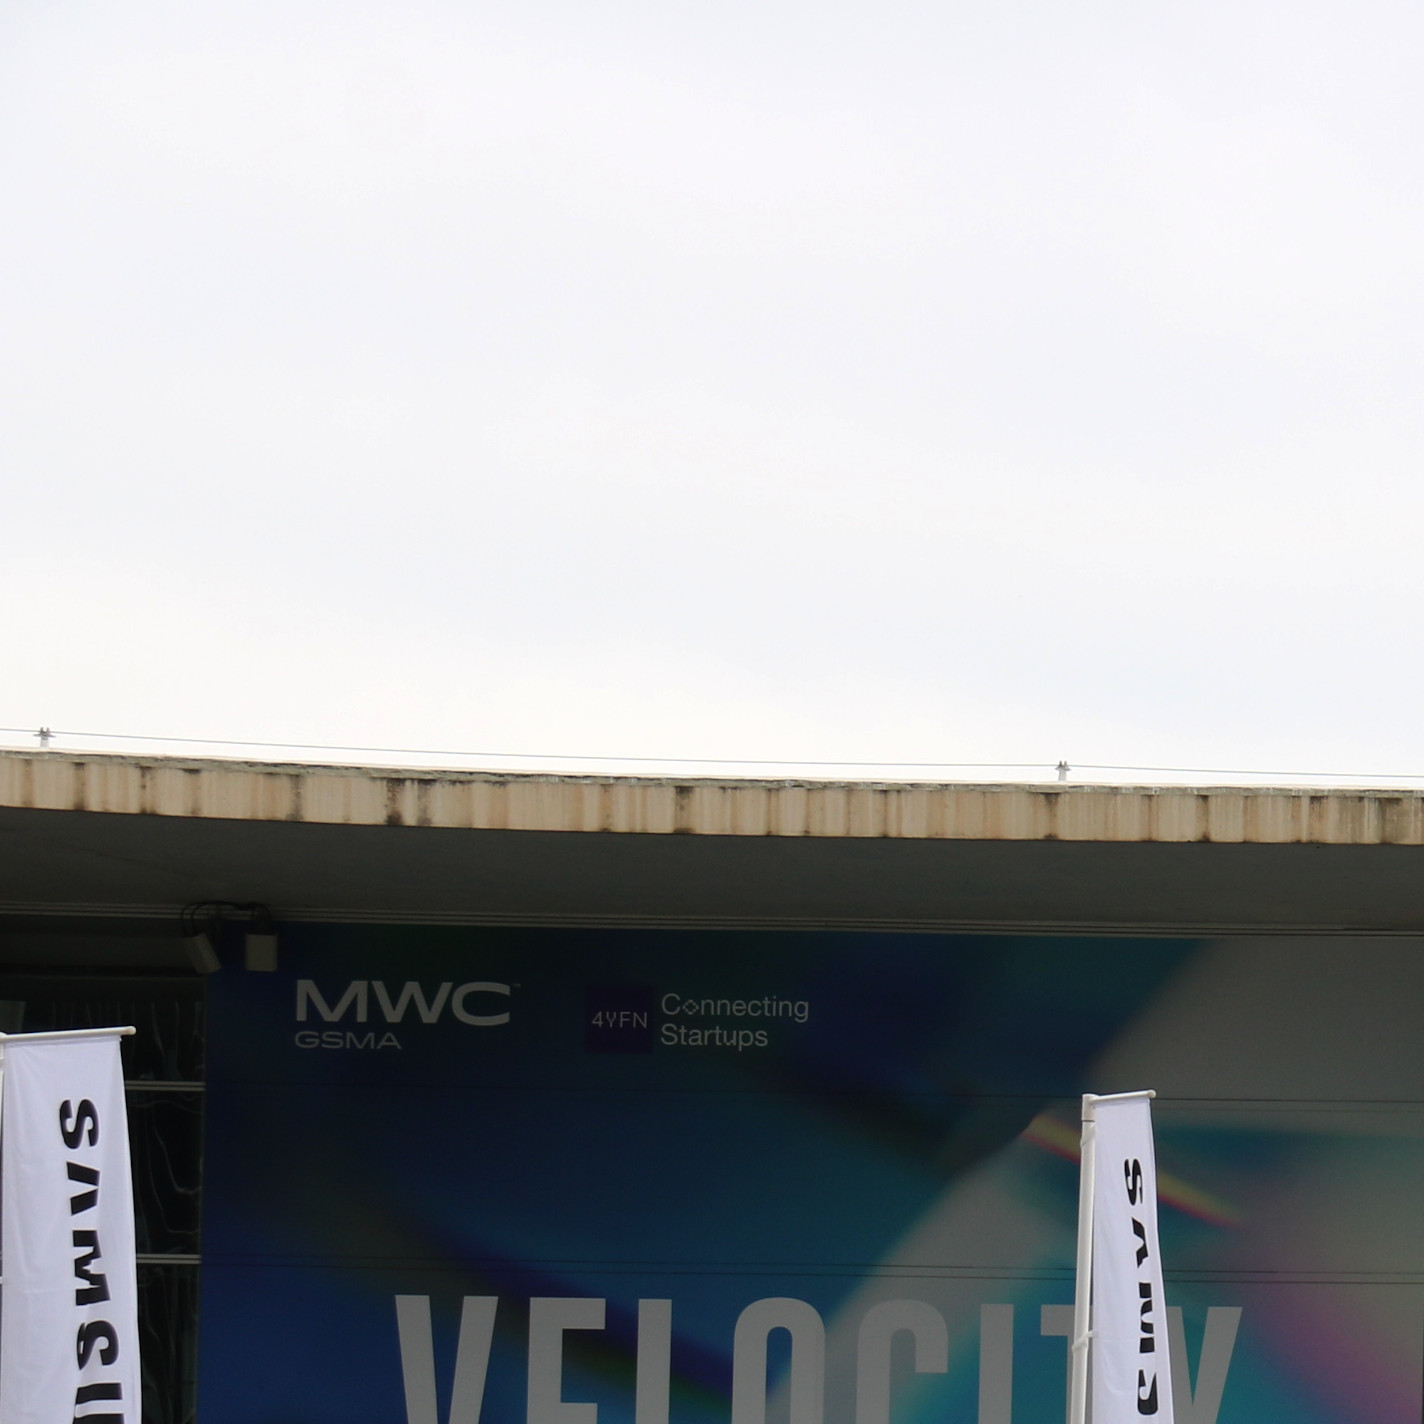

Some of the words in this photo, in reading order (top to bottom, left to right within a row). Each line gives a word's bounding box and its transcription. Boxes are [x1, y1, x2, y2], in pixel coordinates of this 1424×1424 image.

[296, 979, 511, 1027] MWC
[660, 992, 809, 1023] Connecting
[591, 1010, 648, 1029] 4YFN
[294, 1031, 402, 1050] GSMA
[660, 1022, 769, 1051] Startups
